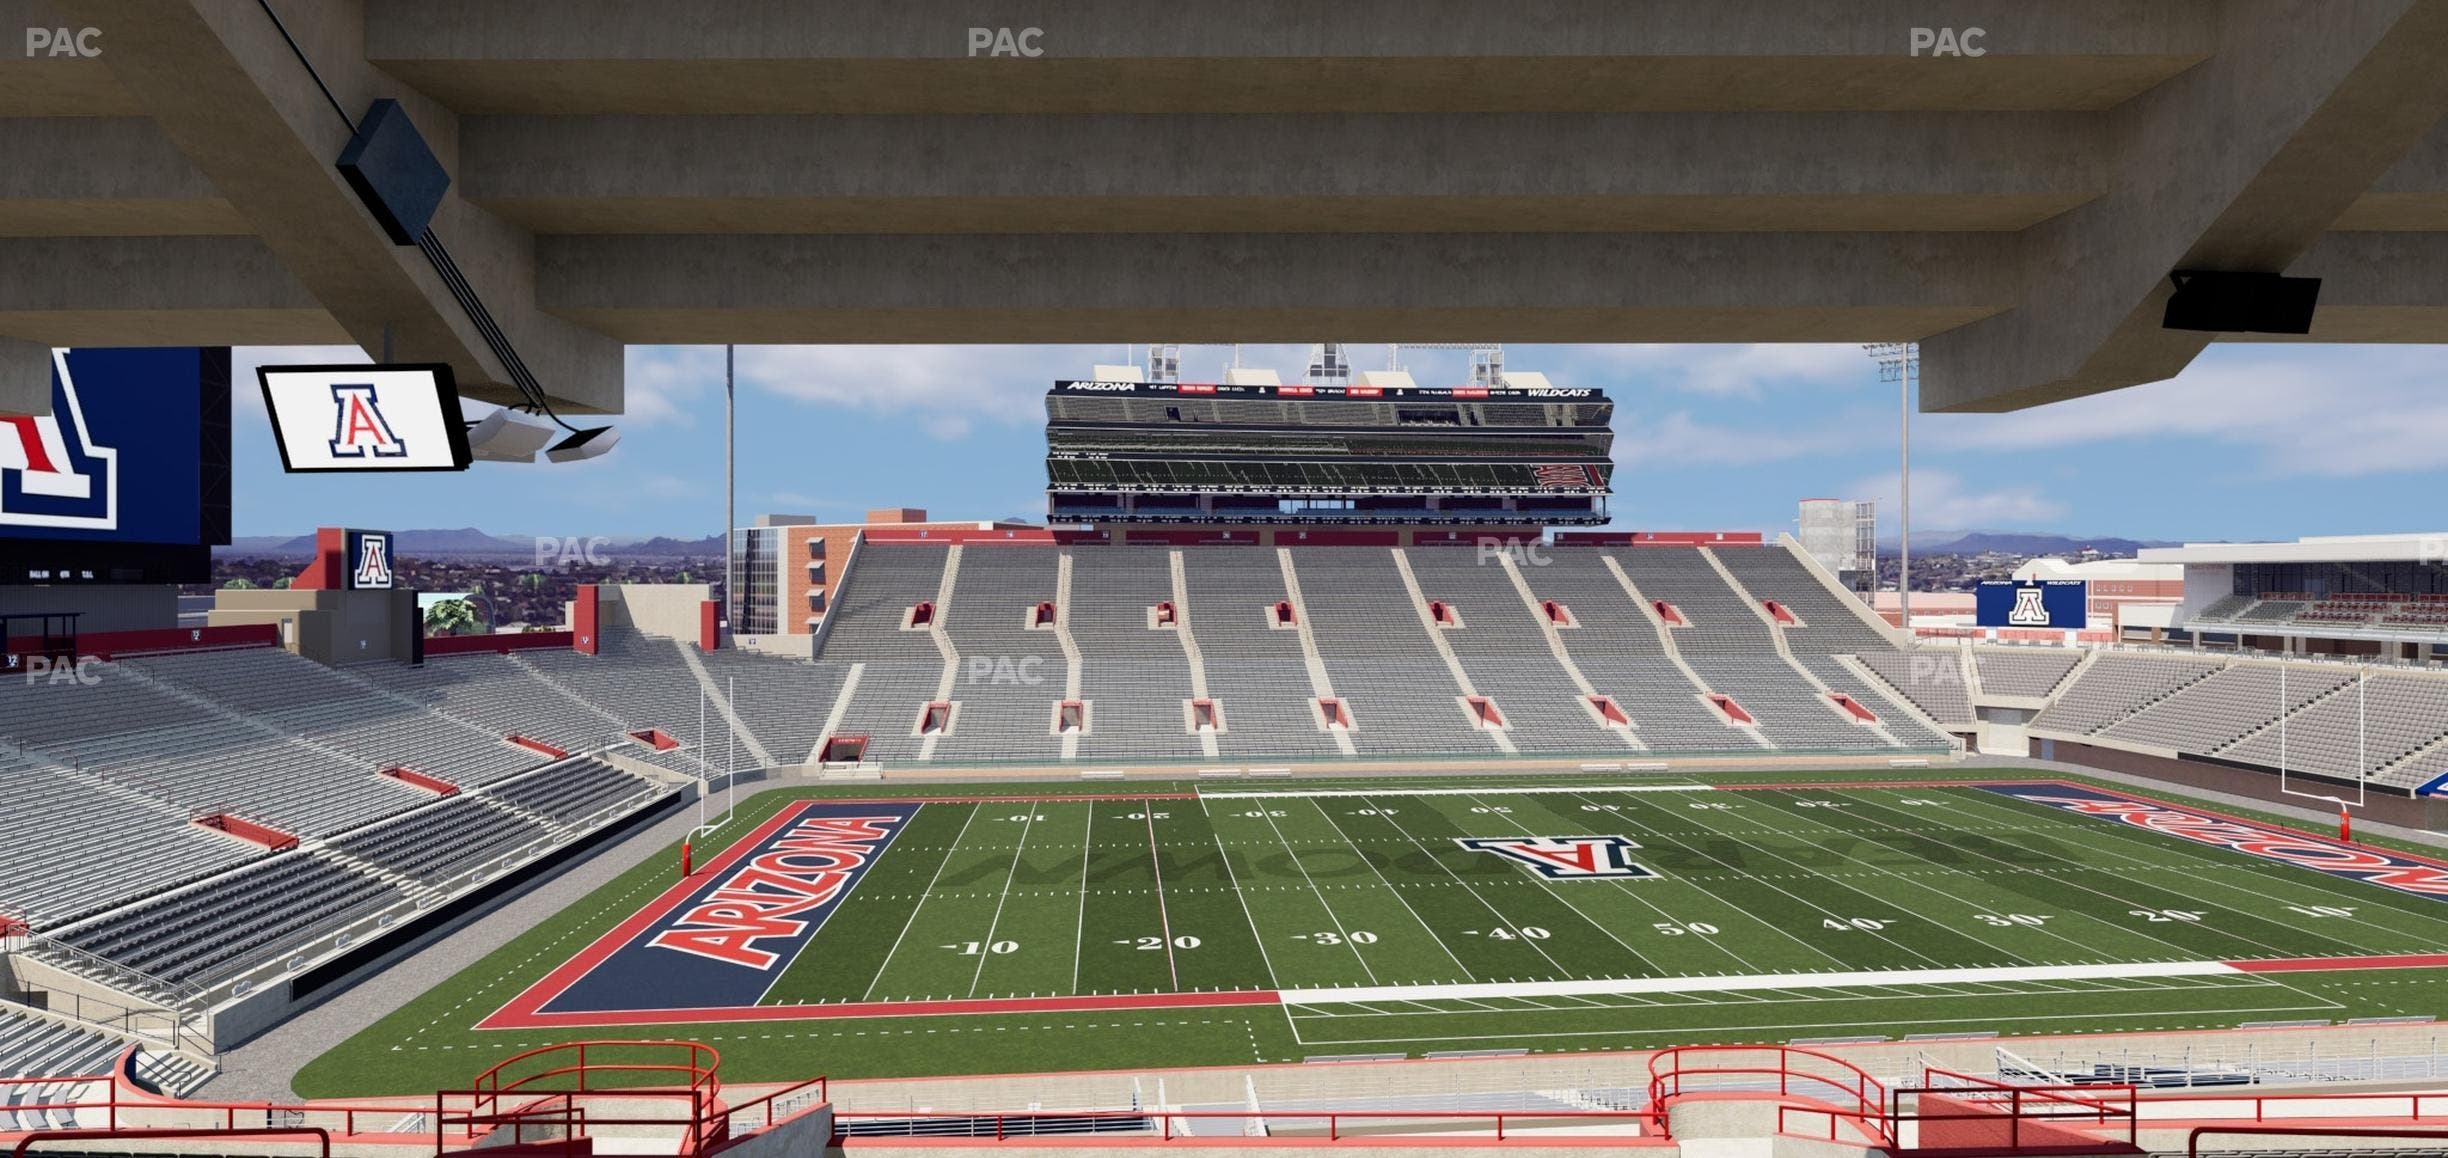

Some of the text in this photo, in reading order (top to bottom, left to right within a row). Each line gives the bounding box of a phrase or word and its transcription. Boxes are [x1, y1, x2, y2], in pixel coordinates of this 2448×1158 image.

[1067, 381, 1136, 392] ARIZONA
[1527, 388, 1592, 398] WILDCATS
[329, 384, 407, 458] A
[354, 534, 392, 589] A
[2008, 588, 2050, 626] A
[1453, 835, 1664, 881] A
[644, 815, 903, 971] ARIZONA
[2128, 909, 2201, 923] 20
[2287, 905, 2352, 918] 10
[1822, 917, 1885, 931] 40
[1974, 913, 2045, 927] 30
[1488, 926, 1551, 940] 40
[1652, 921, 1720, 937] 50
[1137, 935, 1202, 950] 20
[1314, 930, 1378, 945] 30
[958, 940, 1019, 956] 10
